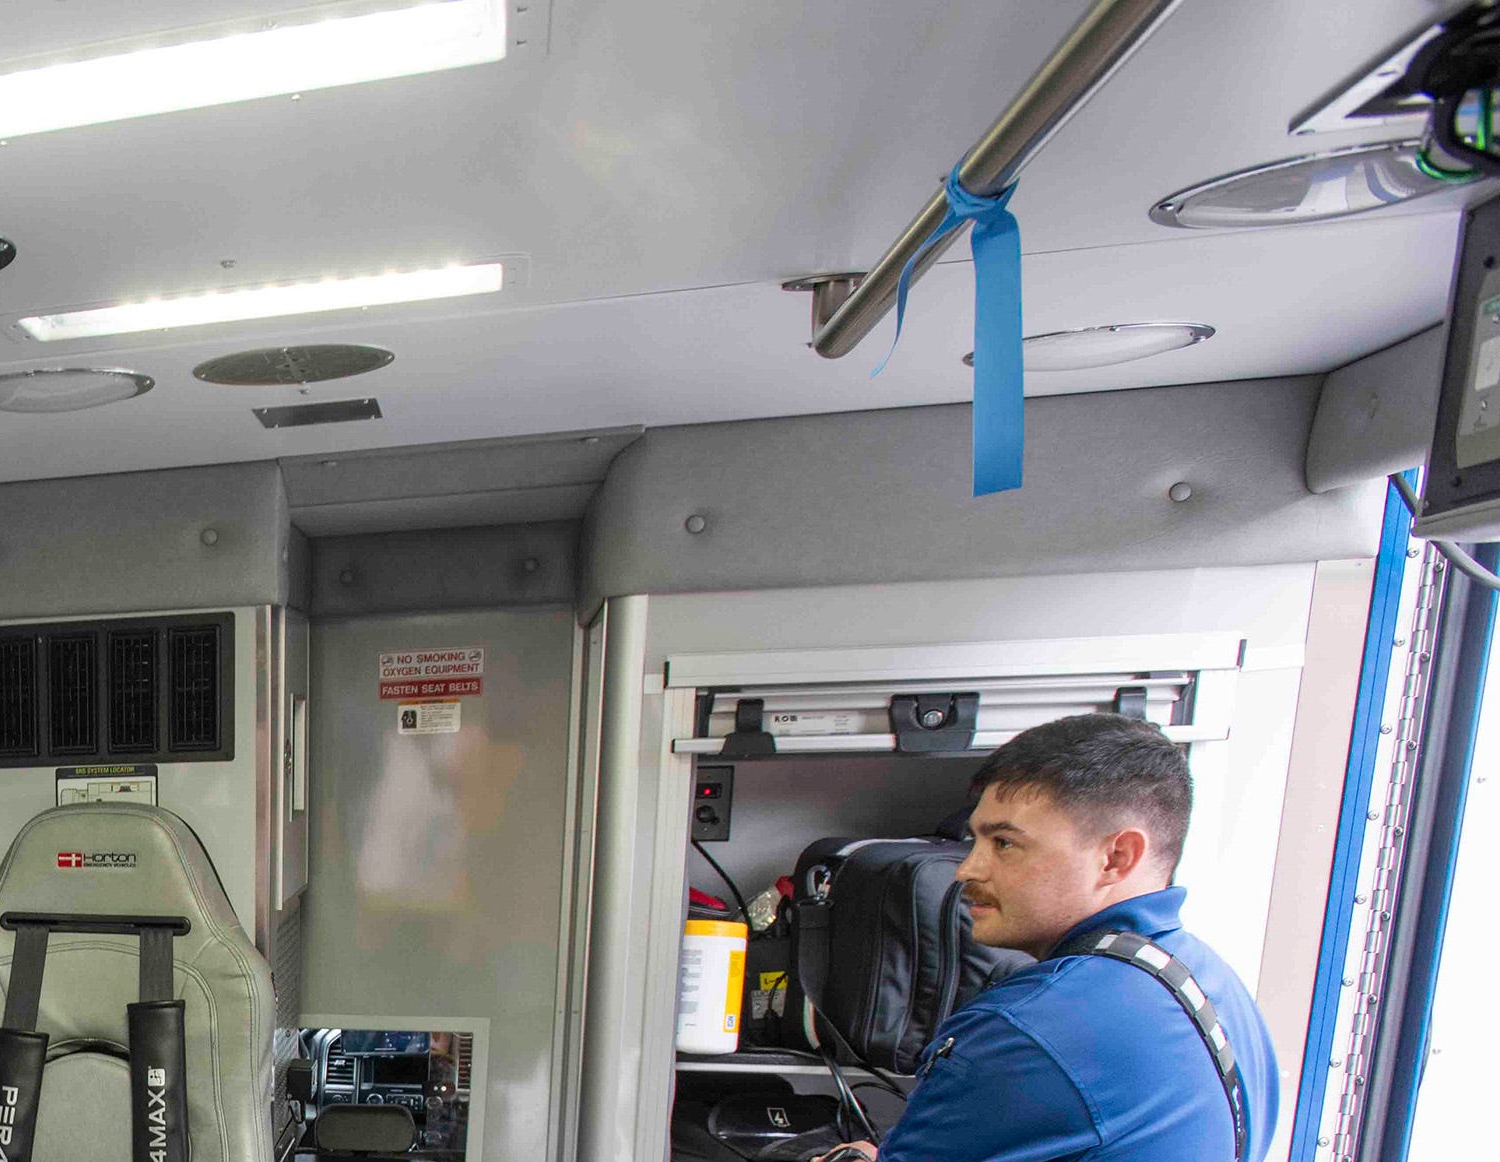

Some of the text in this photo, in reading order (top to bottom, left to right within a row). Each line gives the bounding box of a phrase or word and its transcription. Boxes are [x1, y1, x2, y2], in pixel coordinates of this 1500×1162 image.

[397, 651, 465, 664] NO SMOKING
[382, 662, 480, 677] OXYGEN EQUIPMENT
[382, 681, 479, 696] FASTEN SEAT BELTS
